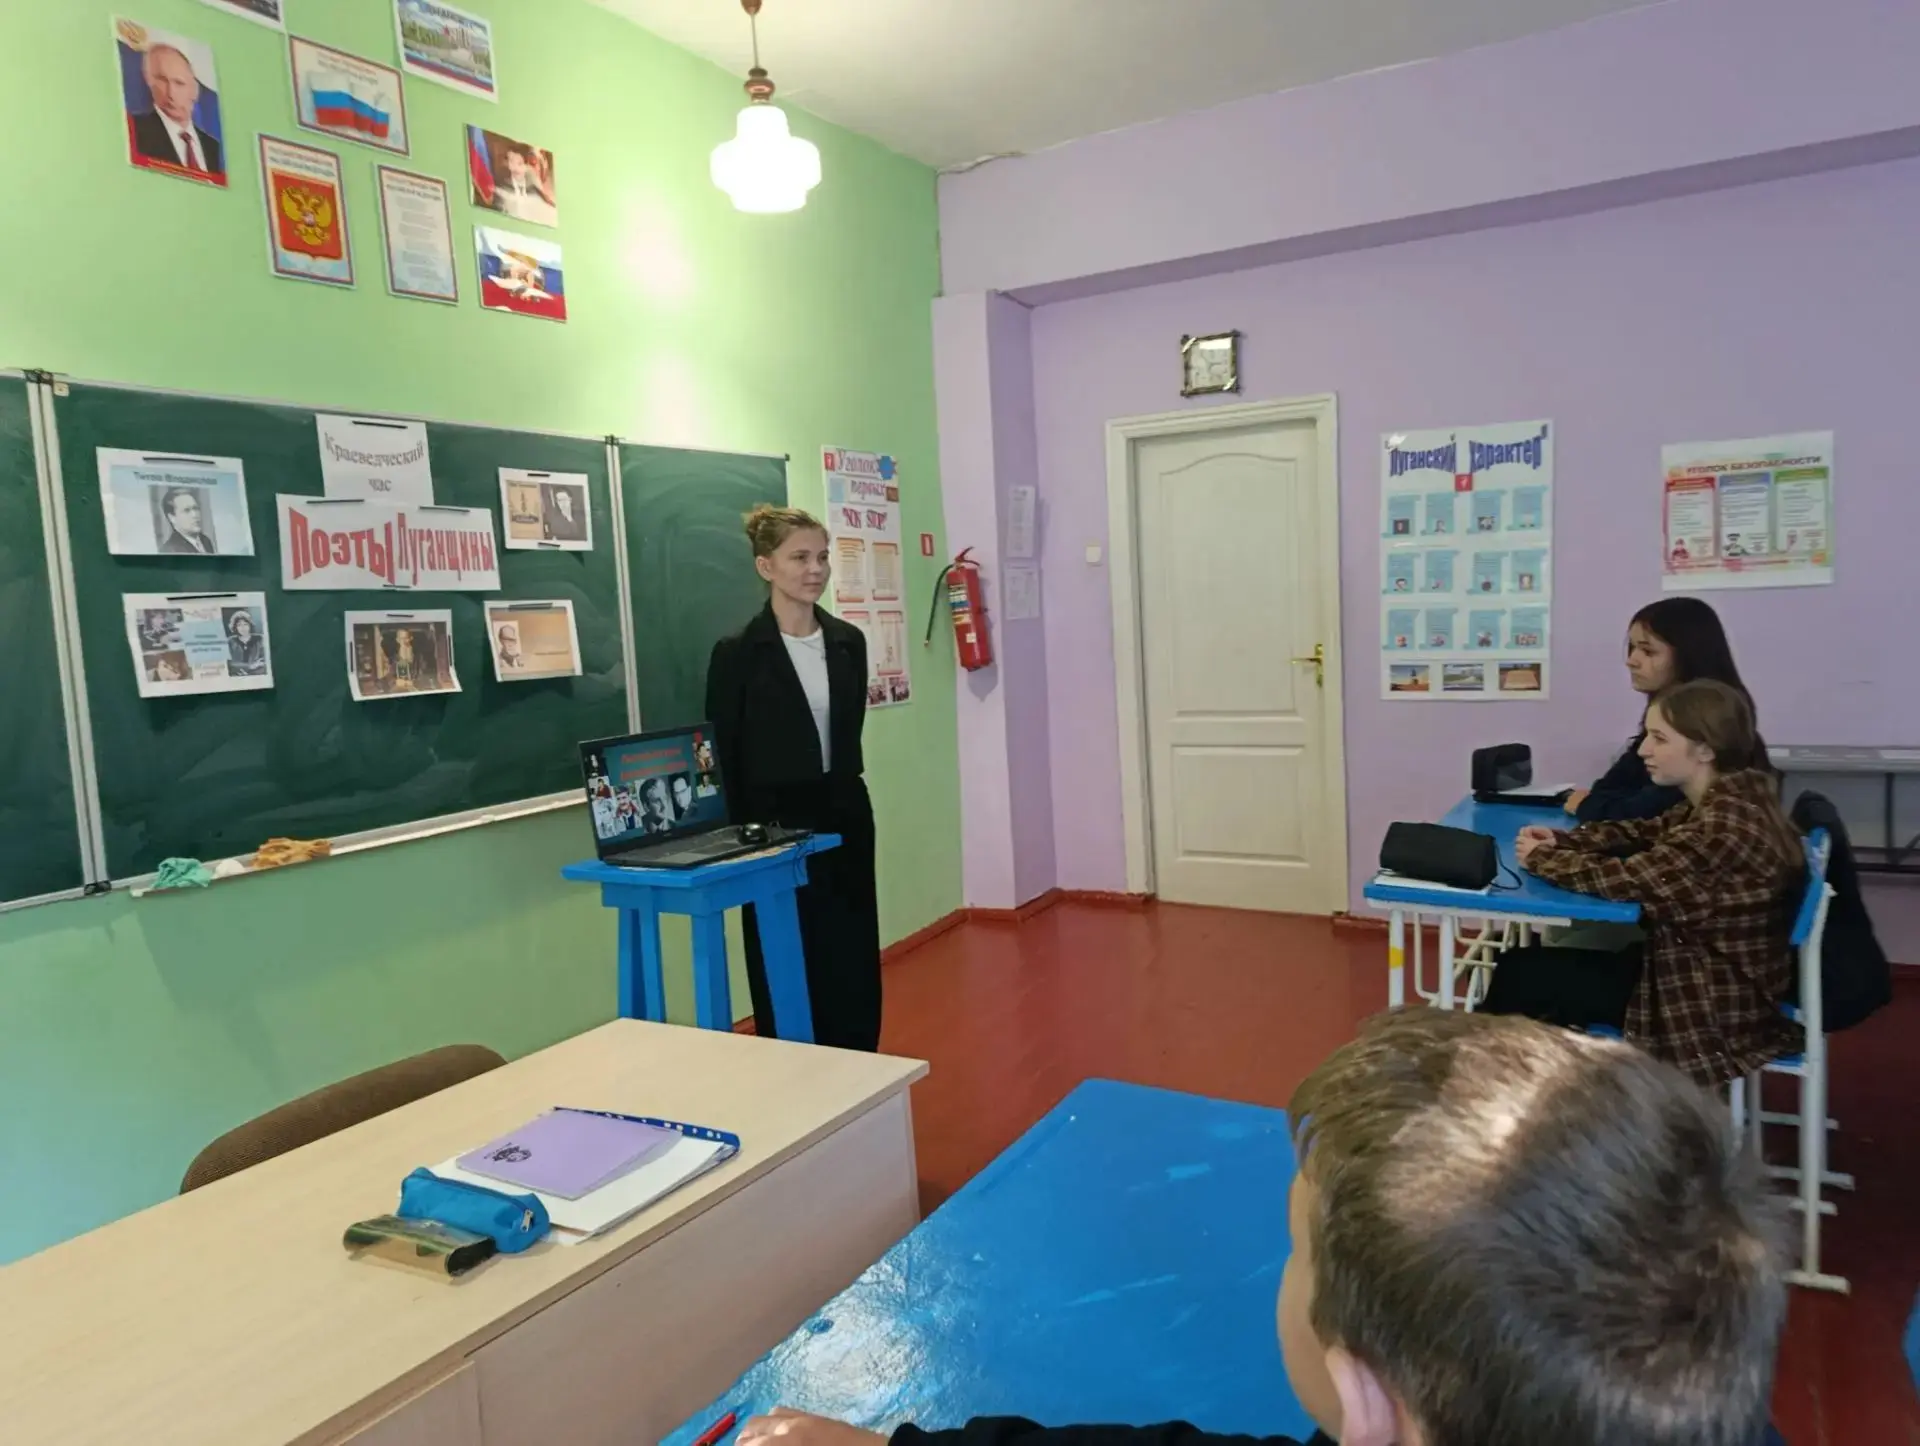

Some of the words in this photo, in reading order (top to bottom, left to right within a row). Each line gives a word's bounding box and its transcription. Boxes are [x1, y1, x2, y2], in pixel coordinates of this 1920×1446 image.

[324, 432, 425, 467] Краеведческий
[368, 478, 393, 492] час
[288, 507, 395, 585] Поэты
[397, 512, 495, 586] Луганщины
